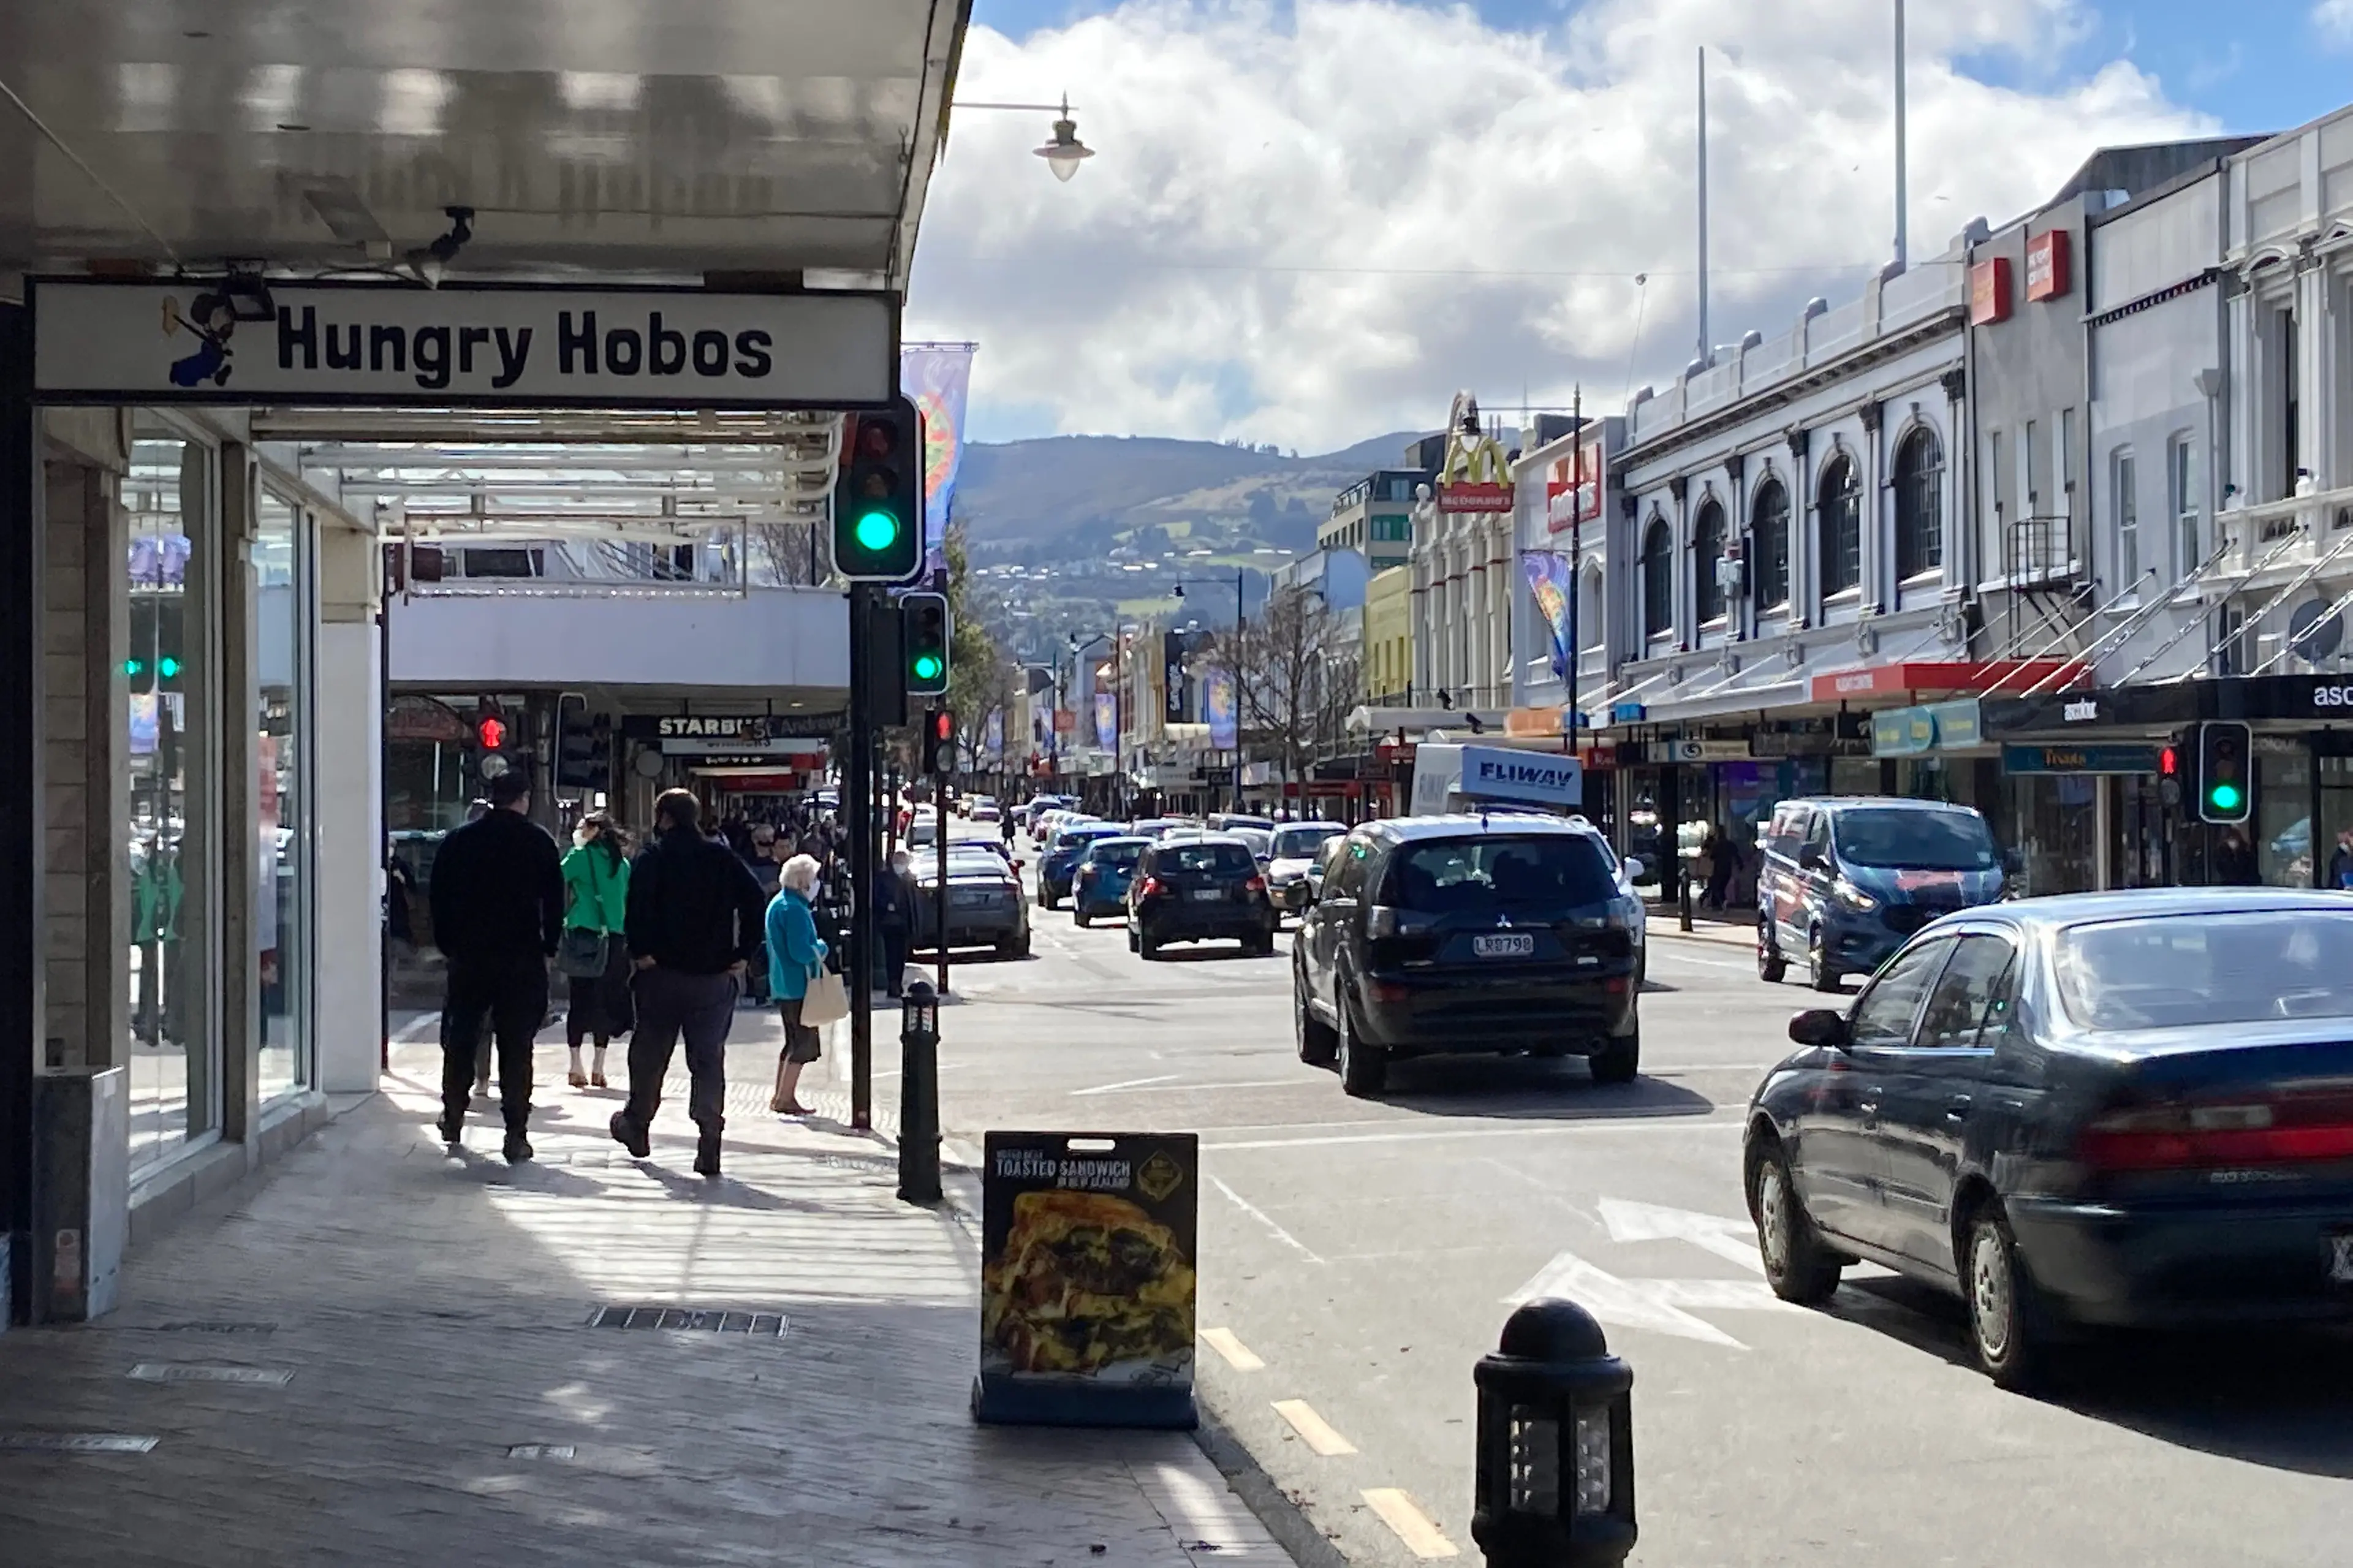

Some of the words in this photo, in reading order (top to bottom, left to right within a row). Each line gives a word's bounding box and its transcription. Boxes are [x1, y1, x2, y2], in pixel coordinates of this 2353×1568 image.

[277, 305, 532, 389] Hungry
[558, 310, 773, 378] Hobos
[753, 716, 773, 739] St
[1479, 762, 1574, 787] FLIWAY
[996, 1159, 1056, 1177] TOASTED
[1059, 1159, 1131, 1178] SANDWICH
